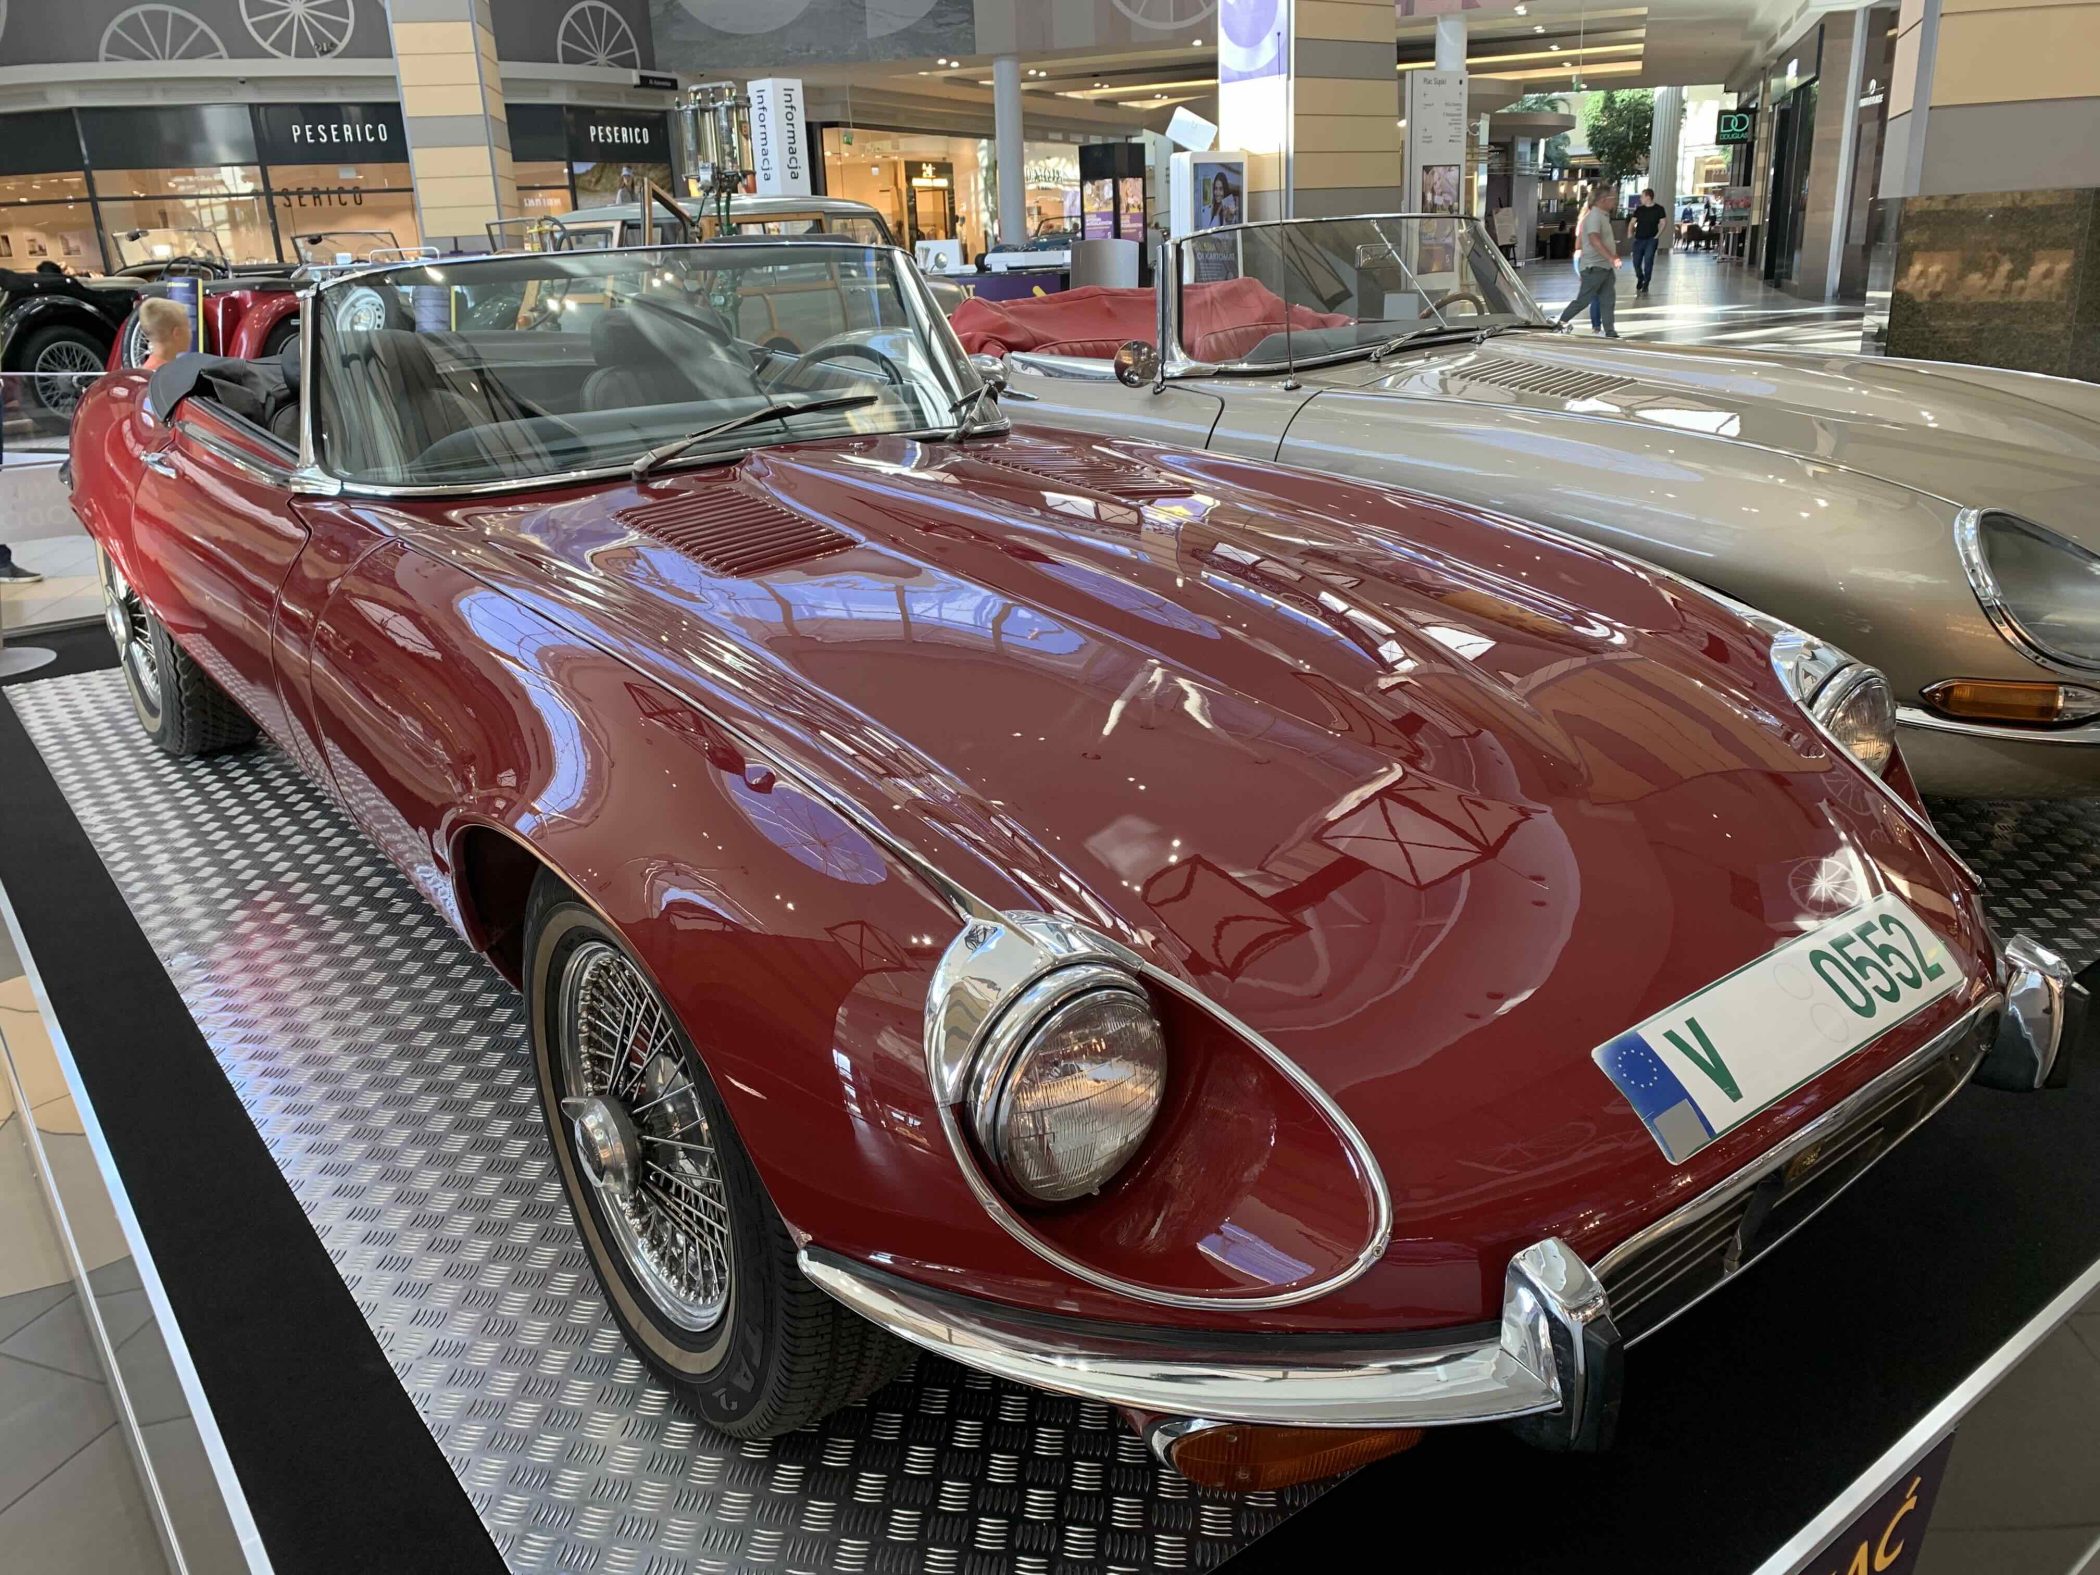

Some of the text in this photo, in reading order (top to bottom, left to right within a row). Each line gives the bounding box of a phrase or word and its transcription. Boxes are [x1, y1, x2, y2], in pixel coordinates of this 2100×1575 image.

[291, 123, 388, 144] PESERICO
[589, 125, 650, 145] PESERICO
[755, 89, 773, 182] Informacja
[783, 88, 801, 181] Informacja
[1662, 912, 1946, 1103] V 0552
